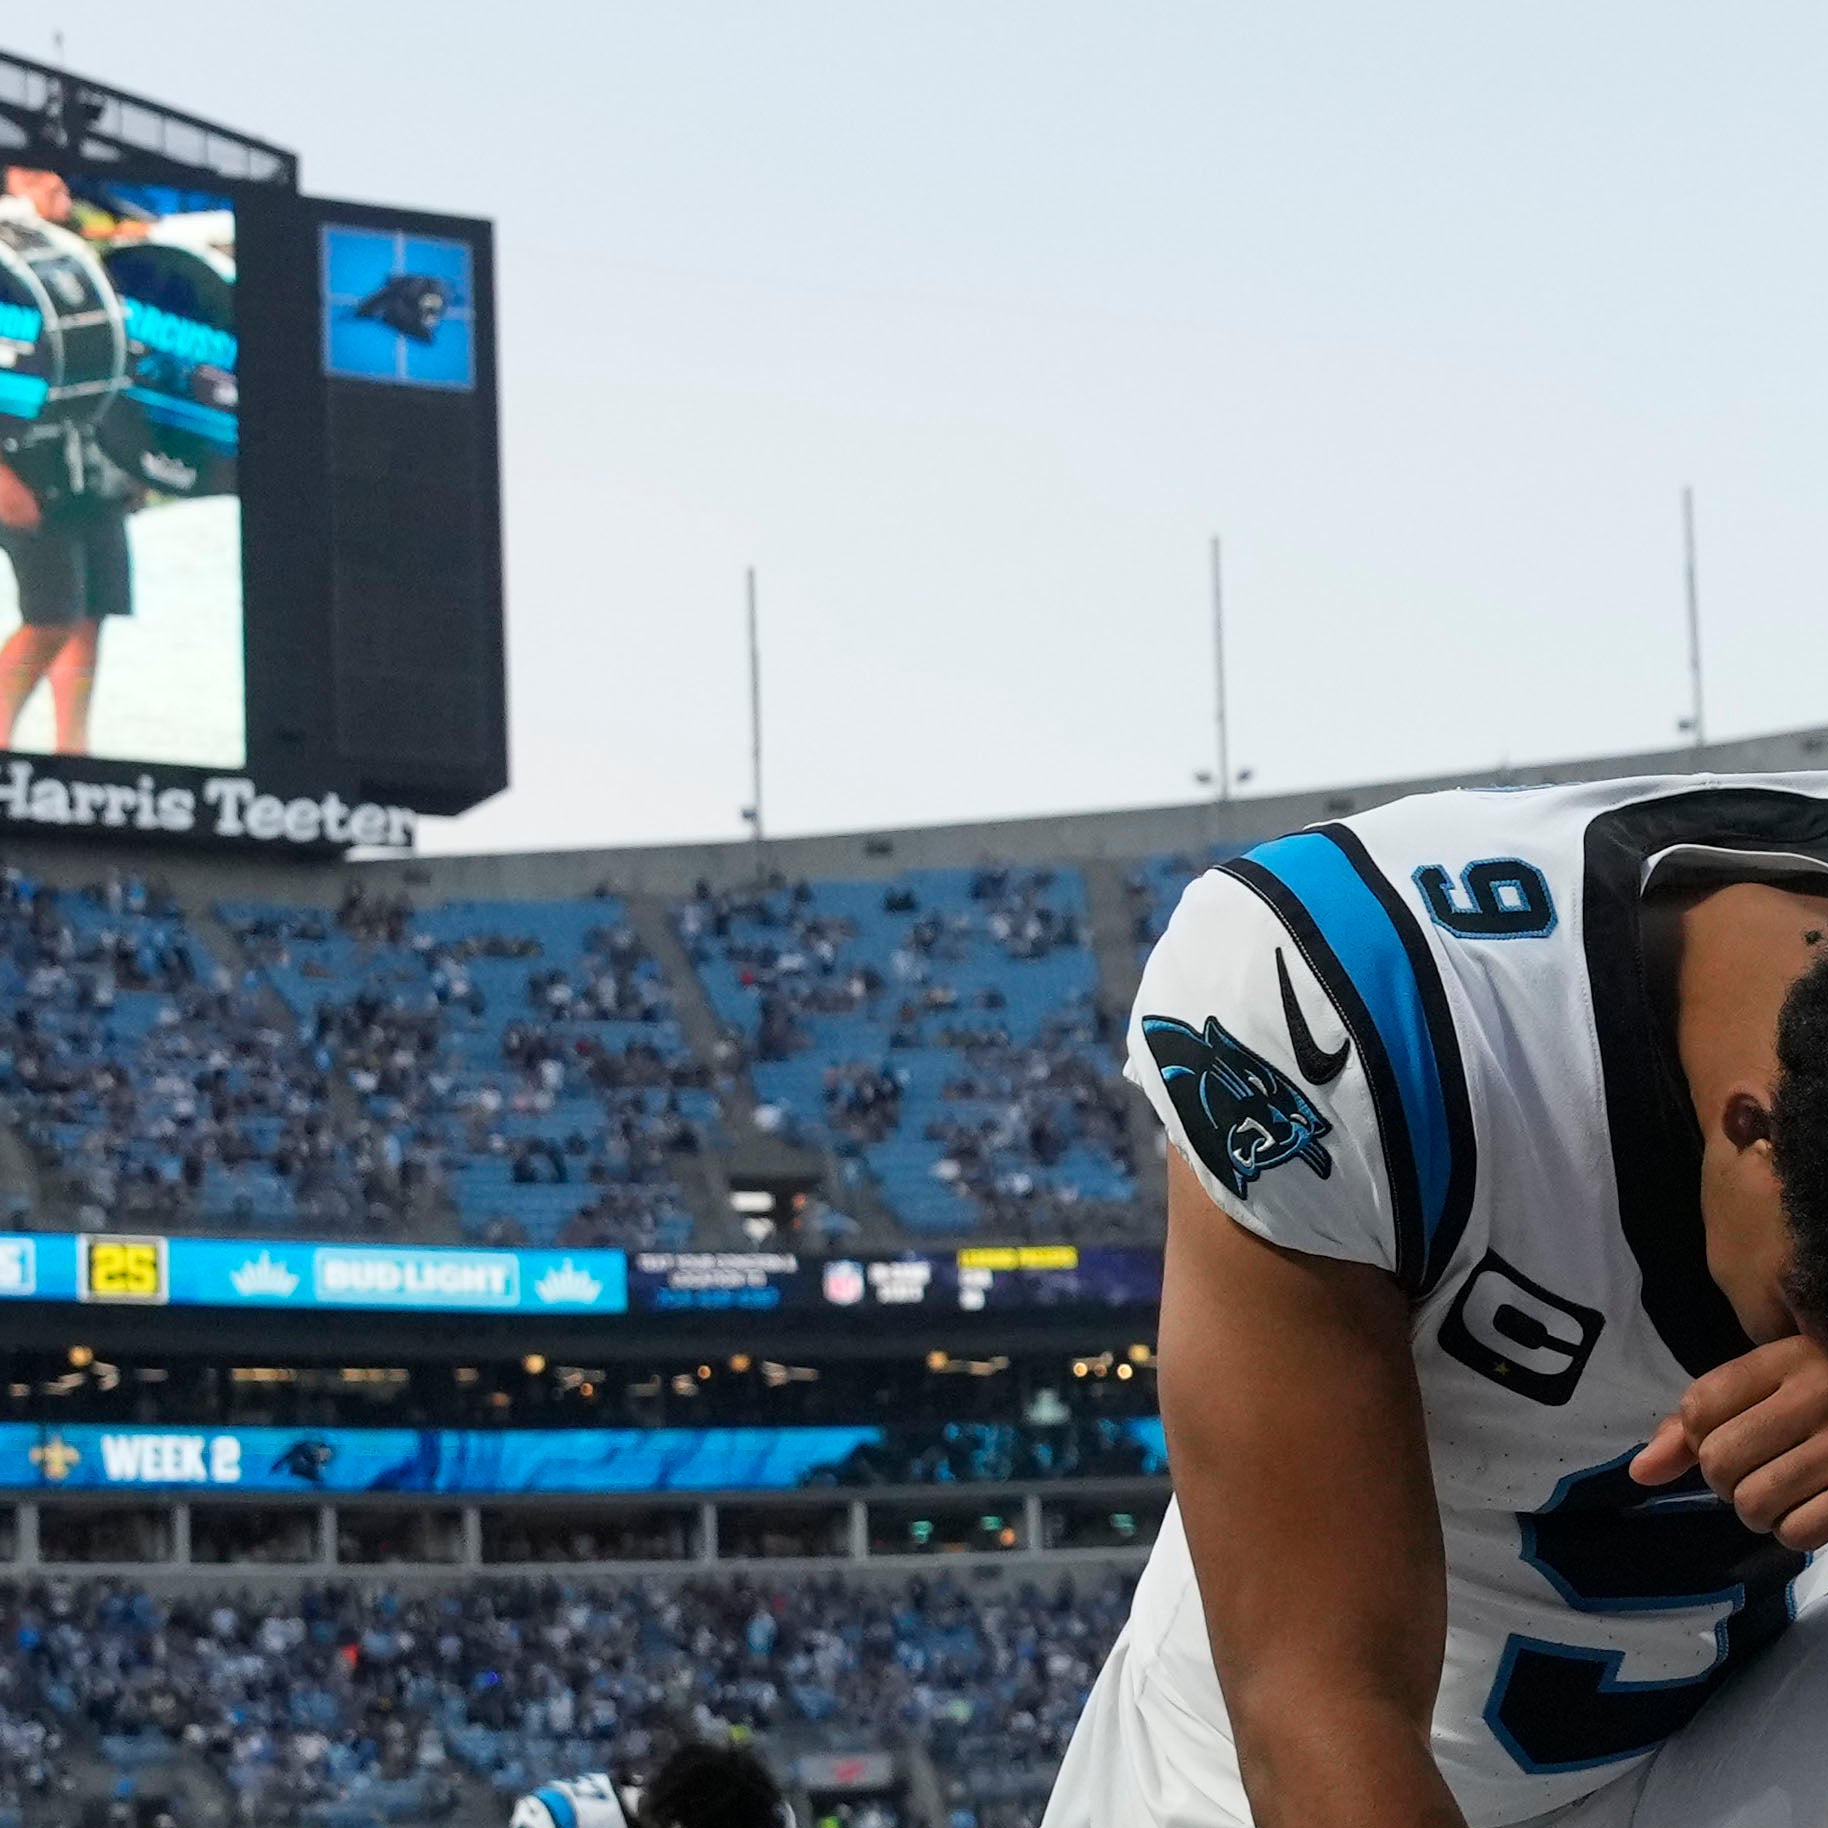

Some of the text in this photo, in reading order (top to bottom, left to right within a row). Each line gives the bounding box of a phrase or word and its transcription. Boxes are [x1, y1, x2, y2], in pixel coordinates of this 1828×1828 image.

[203, 776, 417, 844] Teeter
[1411, 857, 1558, 940] 9
[93, 1243, 157, 1296] 25
[323, 1258, 508, 1295] BUD LIGHT
[1461, 1269, 1585, 1376] C
[101, 1434, 241, 1484] WEEK 2
